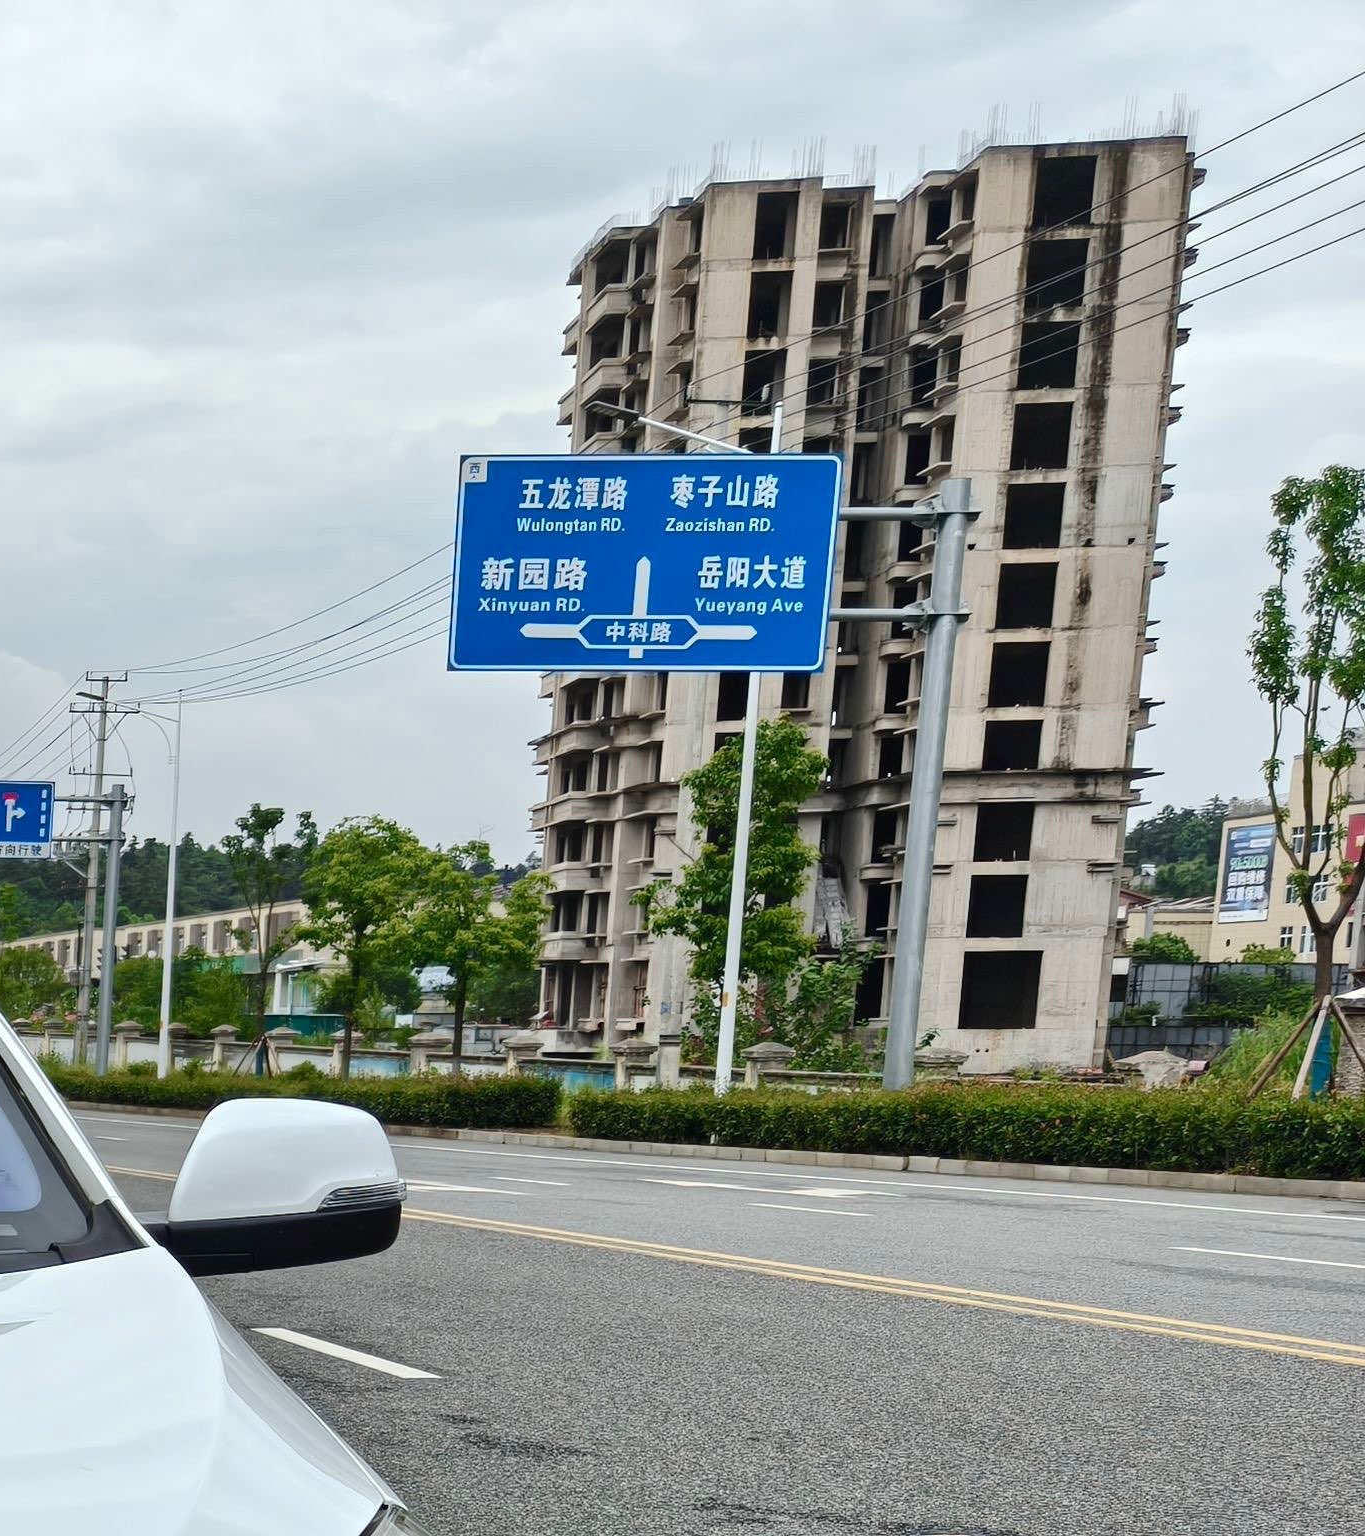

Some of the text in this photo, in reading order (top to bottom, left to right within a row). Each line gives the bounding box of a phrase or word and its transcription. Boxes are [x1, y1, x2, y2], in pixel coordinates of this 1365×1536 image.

[518, 477, 628, 511] 五龙潭路
[670, 474, 779, 509] 枣子山路
[516, 517, 625, 535] Wulongtan RD.
[665, 517, 774, 532] Zaozishan RD.
[480, 557, 588, 591] 新园路
[697, 555, 807, 589] 岳阳大道
[478, 597, 585, 614] Xinyuan RD.
[695, 598, 803, 616] Yueyang Ave
[605, 621, 672, 643] 中科路
